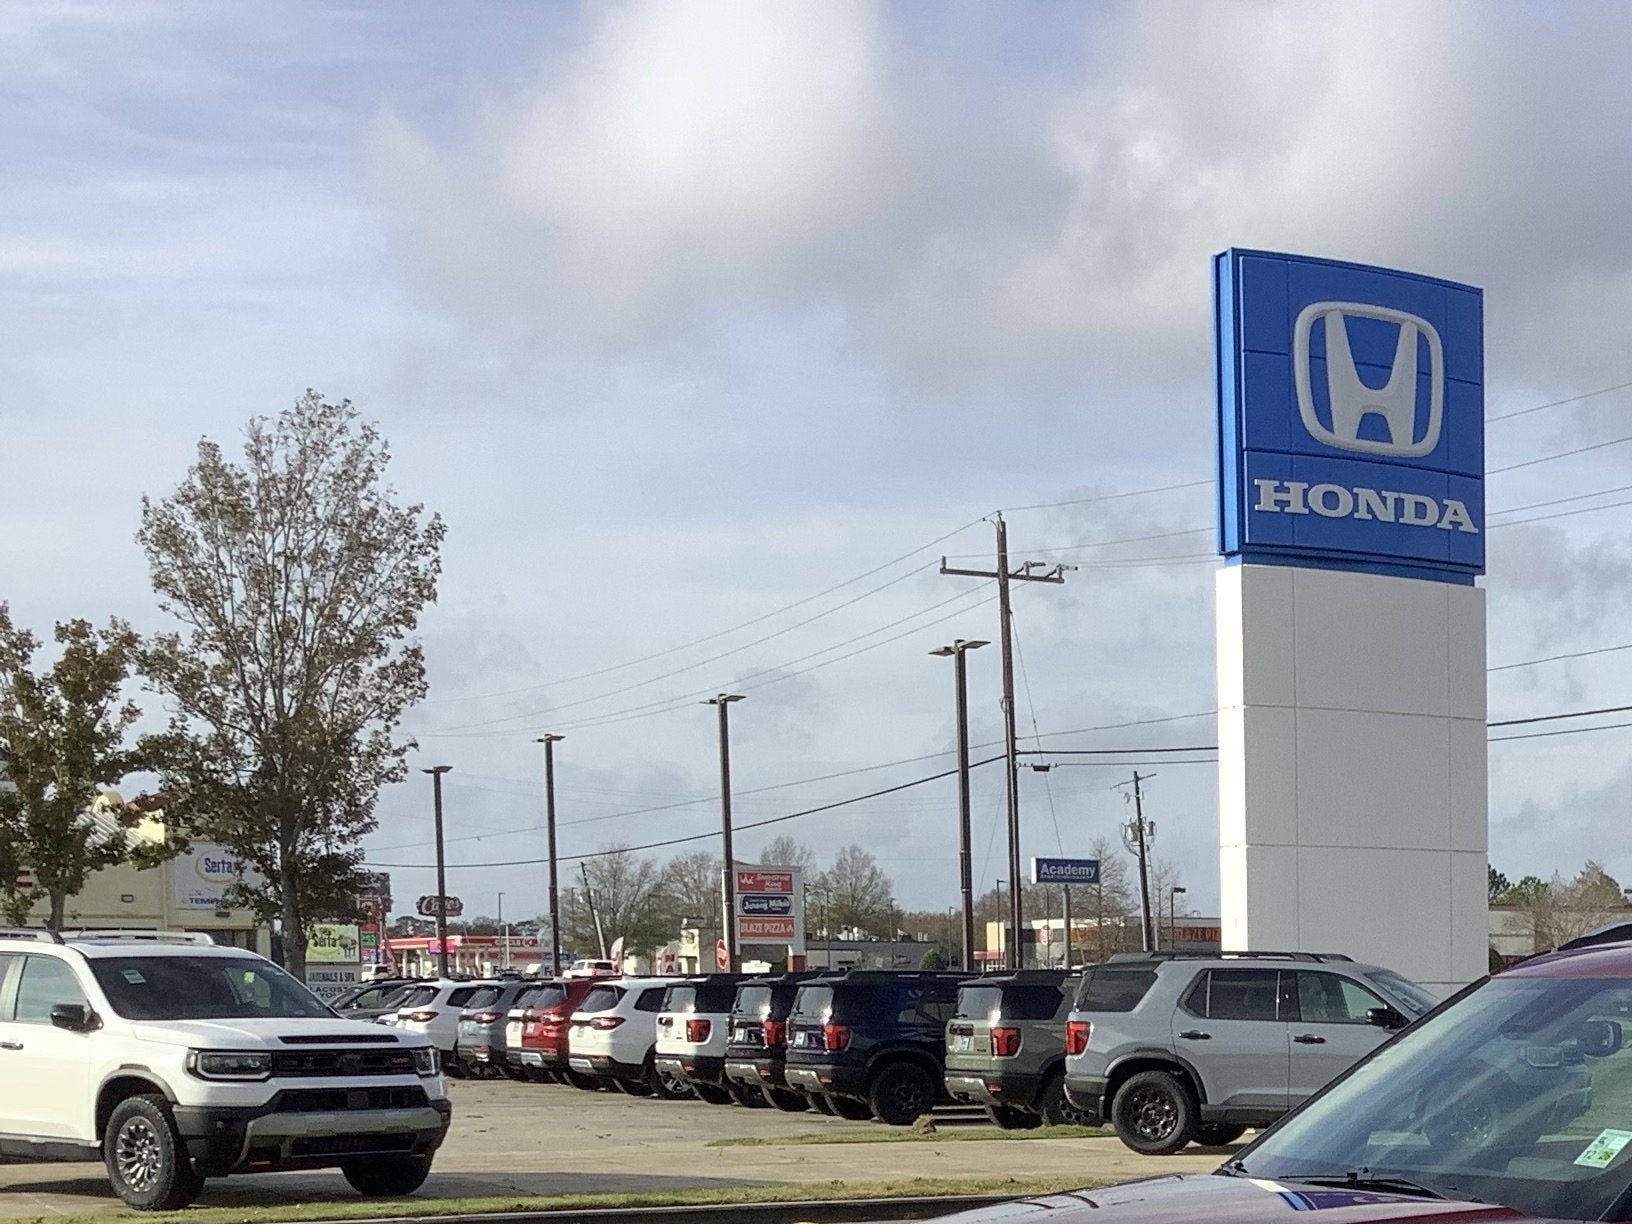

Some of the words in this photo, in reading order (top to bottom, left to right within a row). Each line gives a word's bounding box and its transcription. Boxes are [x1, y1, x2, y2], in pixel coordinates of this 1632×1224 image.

[1254, 479, 1479, 533] HONDA
[205, 857, 232, 873] Serta
[1040, 863, 1096, 878] Academy
[740, 923, 762, 934] BLAZE
[763, 923, 786, 934] PIZZA
